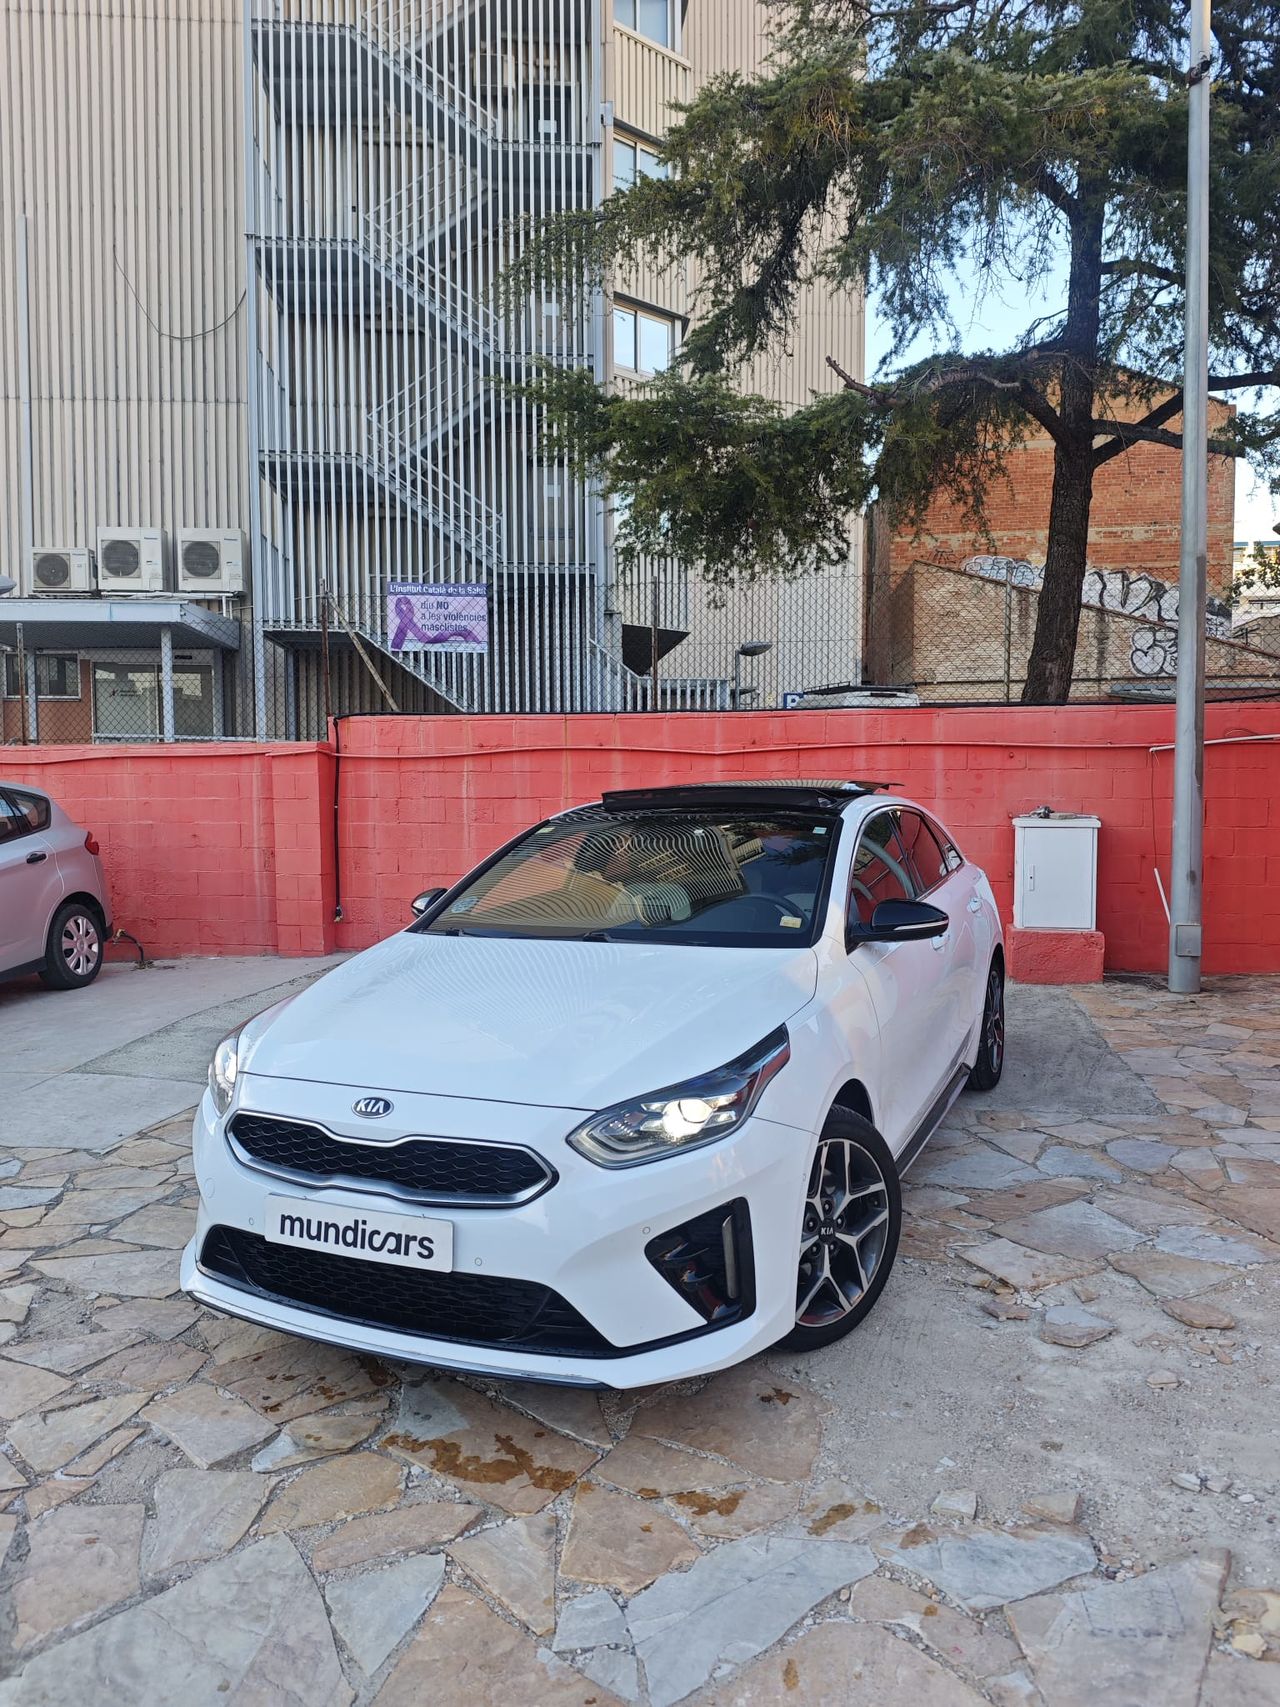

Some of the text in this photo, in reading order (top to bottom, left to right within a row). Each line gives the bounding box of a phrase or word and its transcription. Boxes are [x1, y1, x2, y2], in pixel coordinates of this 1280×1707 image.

[390, 584, 487, 595] L'Institut Català de la Salut
[420, 601, 449, 610] diu NO
[428, 612, 441, 621] les
[443, 612, 487, 622] violències
[421, 623, 468, 632] masclistes
[356, 1099, 385, 1114] KIA
[820, 1226, 834, 1236] KIA
[279, 1213, 435, 1260] mundicars
